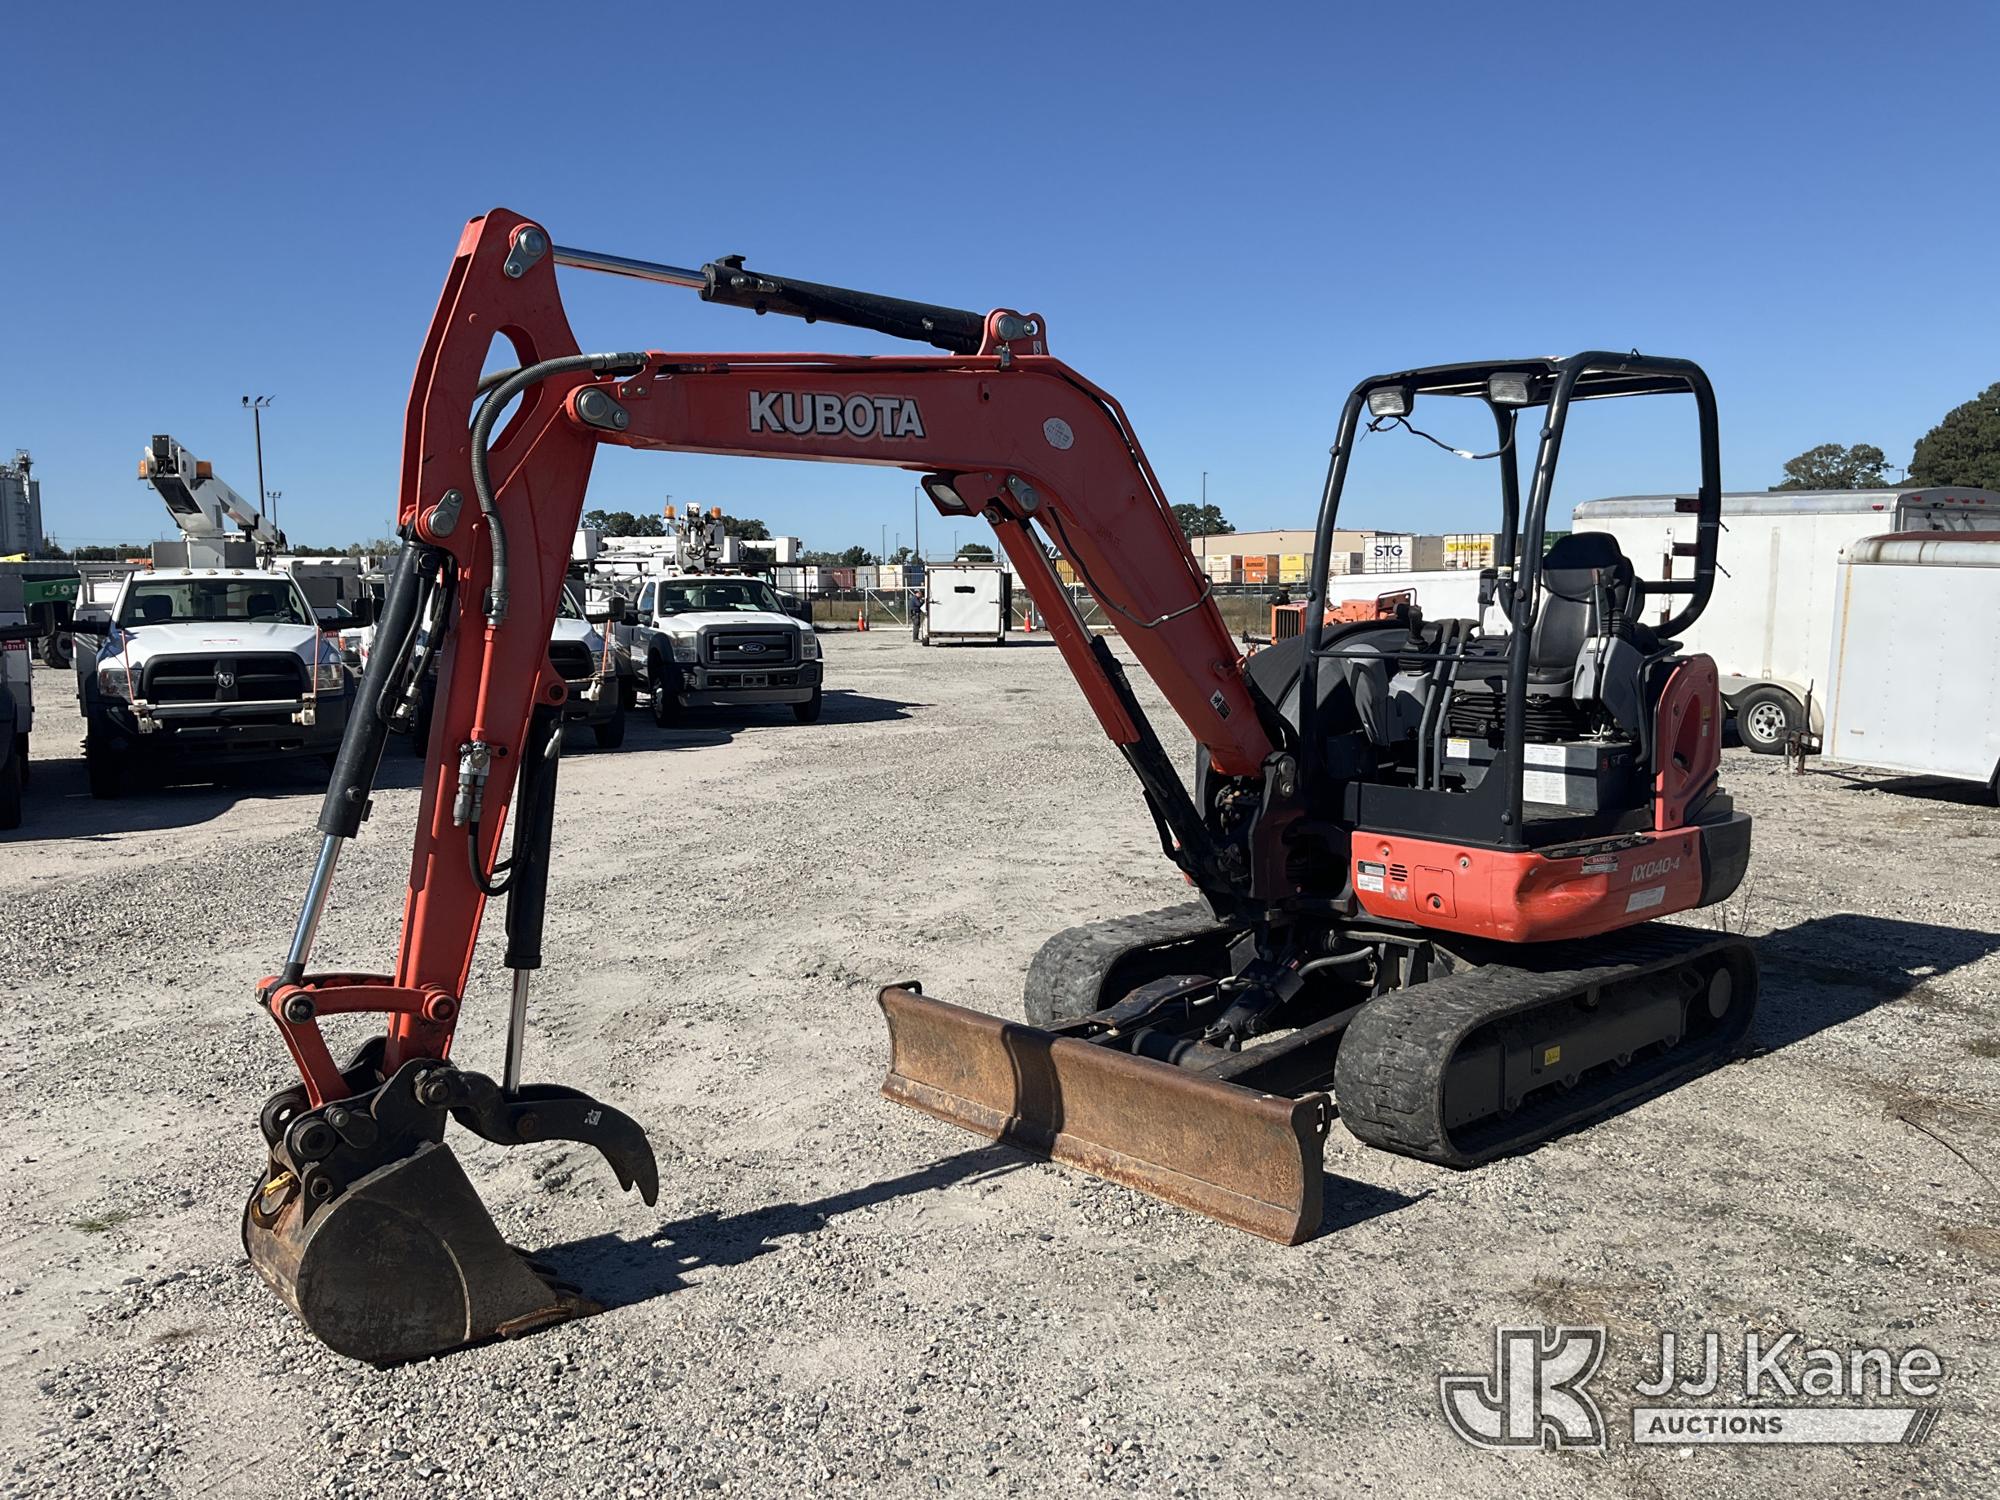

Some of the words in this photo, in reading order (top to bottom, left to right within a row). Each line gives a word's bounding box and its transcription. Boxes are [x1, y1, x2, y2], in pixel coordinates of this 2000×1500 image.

[749, 390, 926, 439] KUBOTA
[1374, 545, 1403, 557] STG
[1630, 857, 1681, 882] KX040-4
